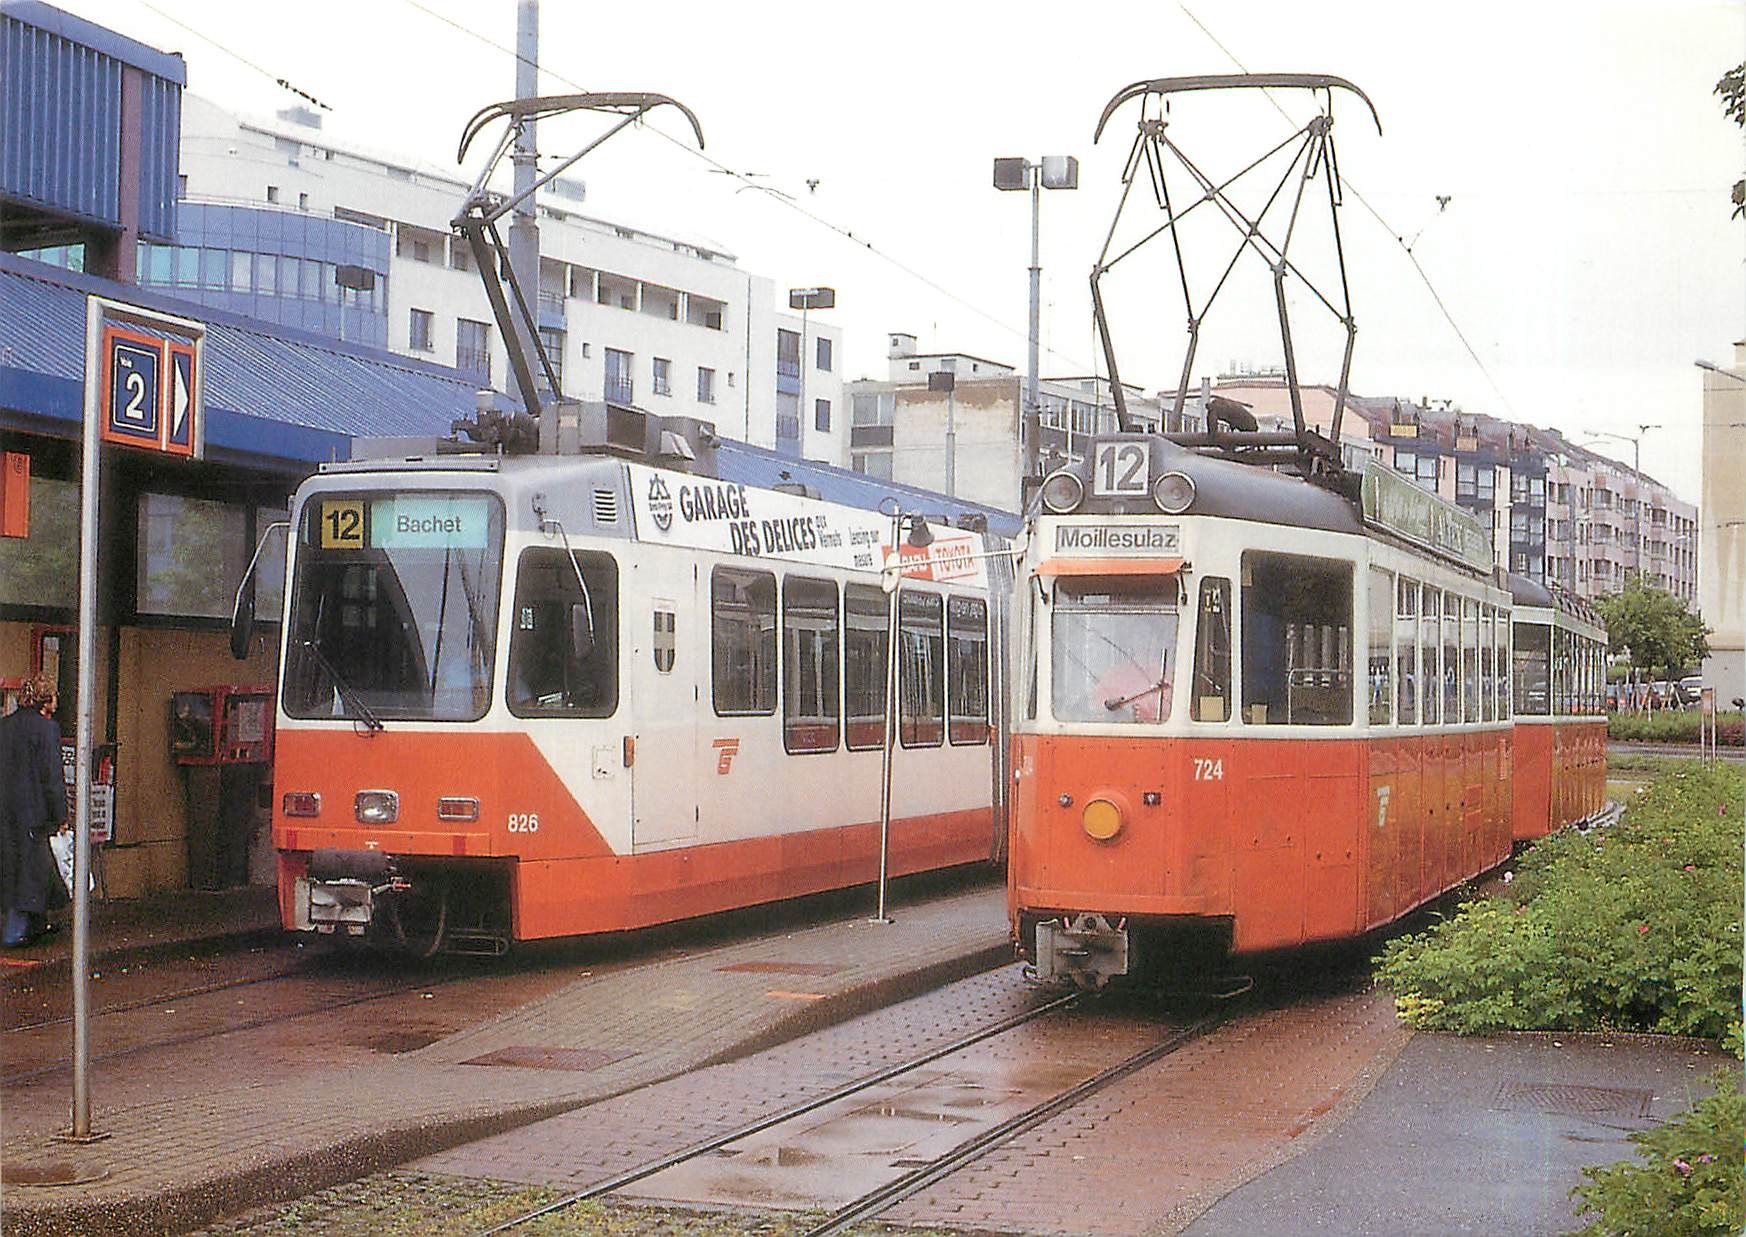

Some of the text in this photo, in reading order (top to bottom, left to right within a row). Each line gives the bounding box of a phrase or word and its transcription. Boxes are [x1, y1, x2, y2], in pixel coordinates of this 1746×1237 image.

[125, 372, 146, 420] 2
[1099, 445, 1145, 491] 12
[679, 484, 750, 523] GARAGE
[326, 509, 360, 541] 12
[396, 515, 462, 533] Bachet
[730, 516, 817, 556] DES DELICES
[1060, 527, 1177, 548] Moillesulaz
[934, 544, 976, 573] TOYOTA
[1193, 758, 1224, 781] 724
[507, 813, 538, 833] 826
